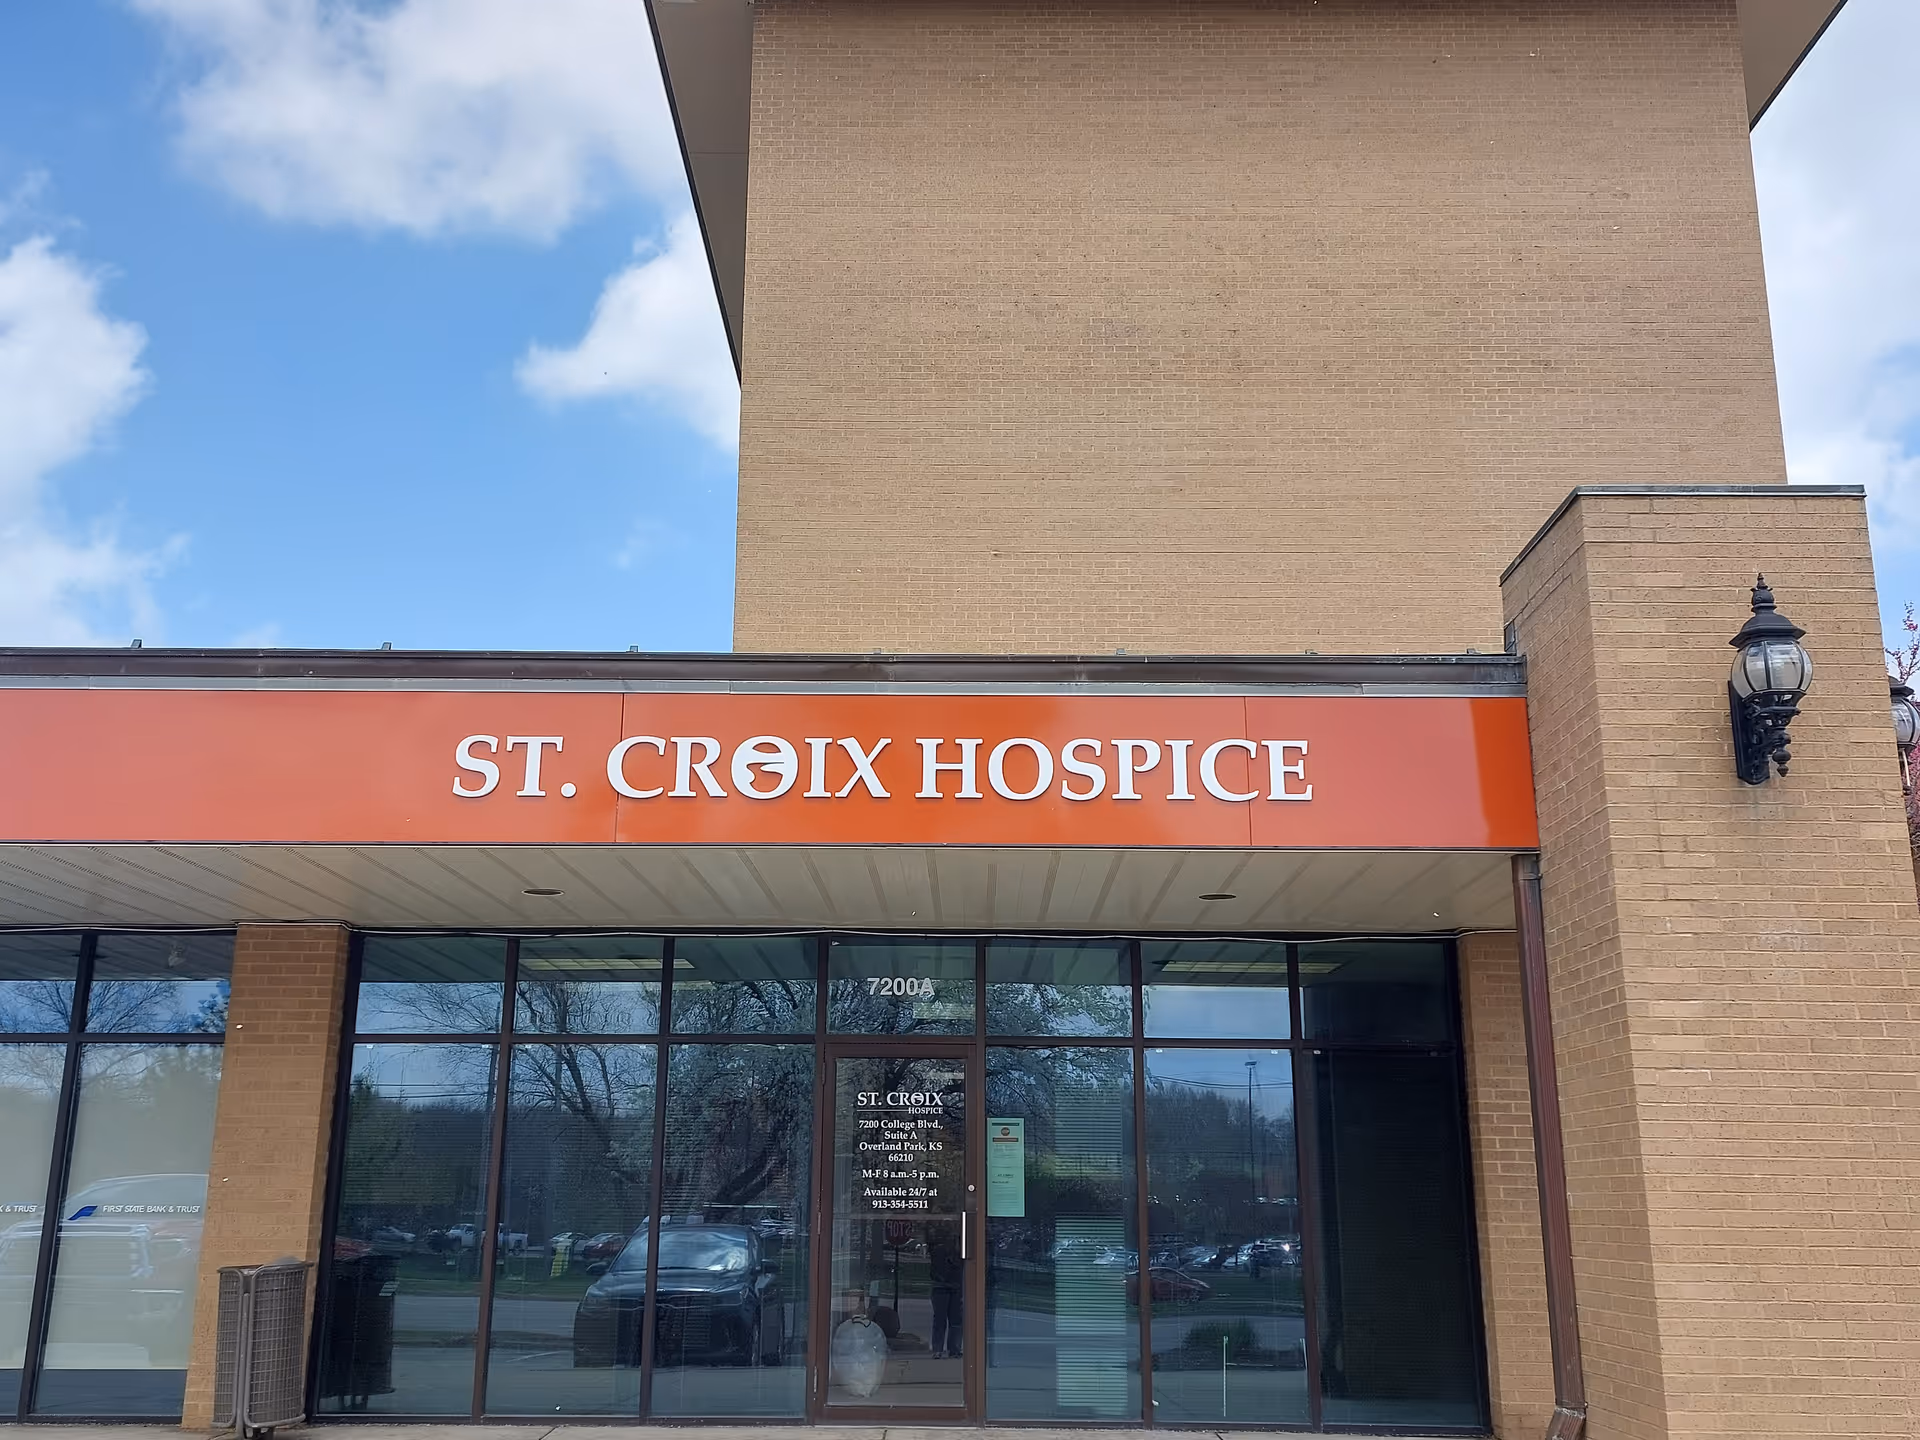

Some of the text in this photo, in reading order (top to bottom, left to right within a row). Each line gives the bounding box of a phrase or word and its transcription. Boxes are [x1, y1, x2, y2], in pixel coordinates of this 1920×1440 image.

[452, 734, 1313, 802] ST. CROIX HOSPICE
[867, 977, 935, 996] 7200A
[857, 1091, 943, 1106] ST. CROIX
[858, 1120, 944, 1130] 7200 College Blvd.,
[884, 1131, 918, 1140] Suite A
[859, 1142, 943, 1152] Overland Park, KS
[888, 1154, 914, 1162] 66210
[862, 1169, 940, 1180] M-F 8 a.m.-5 p.m.
[864, 1187, 938, 1197] Available 24/7 at
[5, 1205, 12, 1213] &
[13, 1205, 38, 1213] TRUST
[103, 1205, 201, 1213] FIRST STATE BANK & TRUST
[872, 1200, 929, 1209] 913-354-5511
